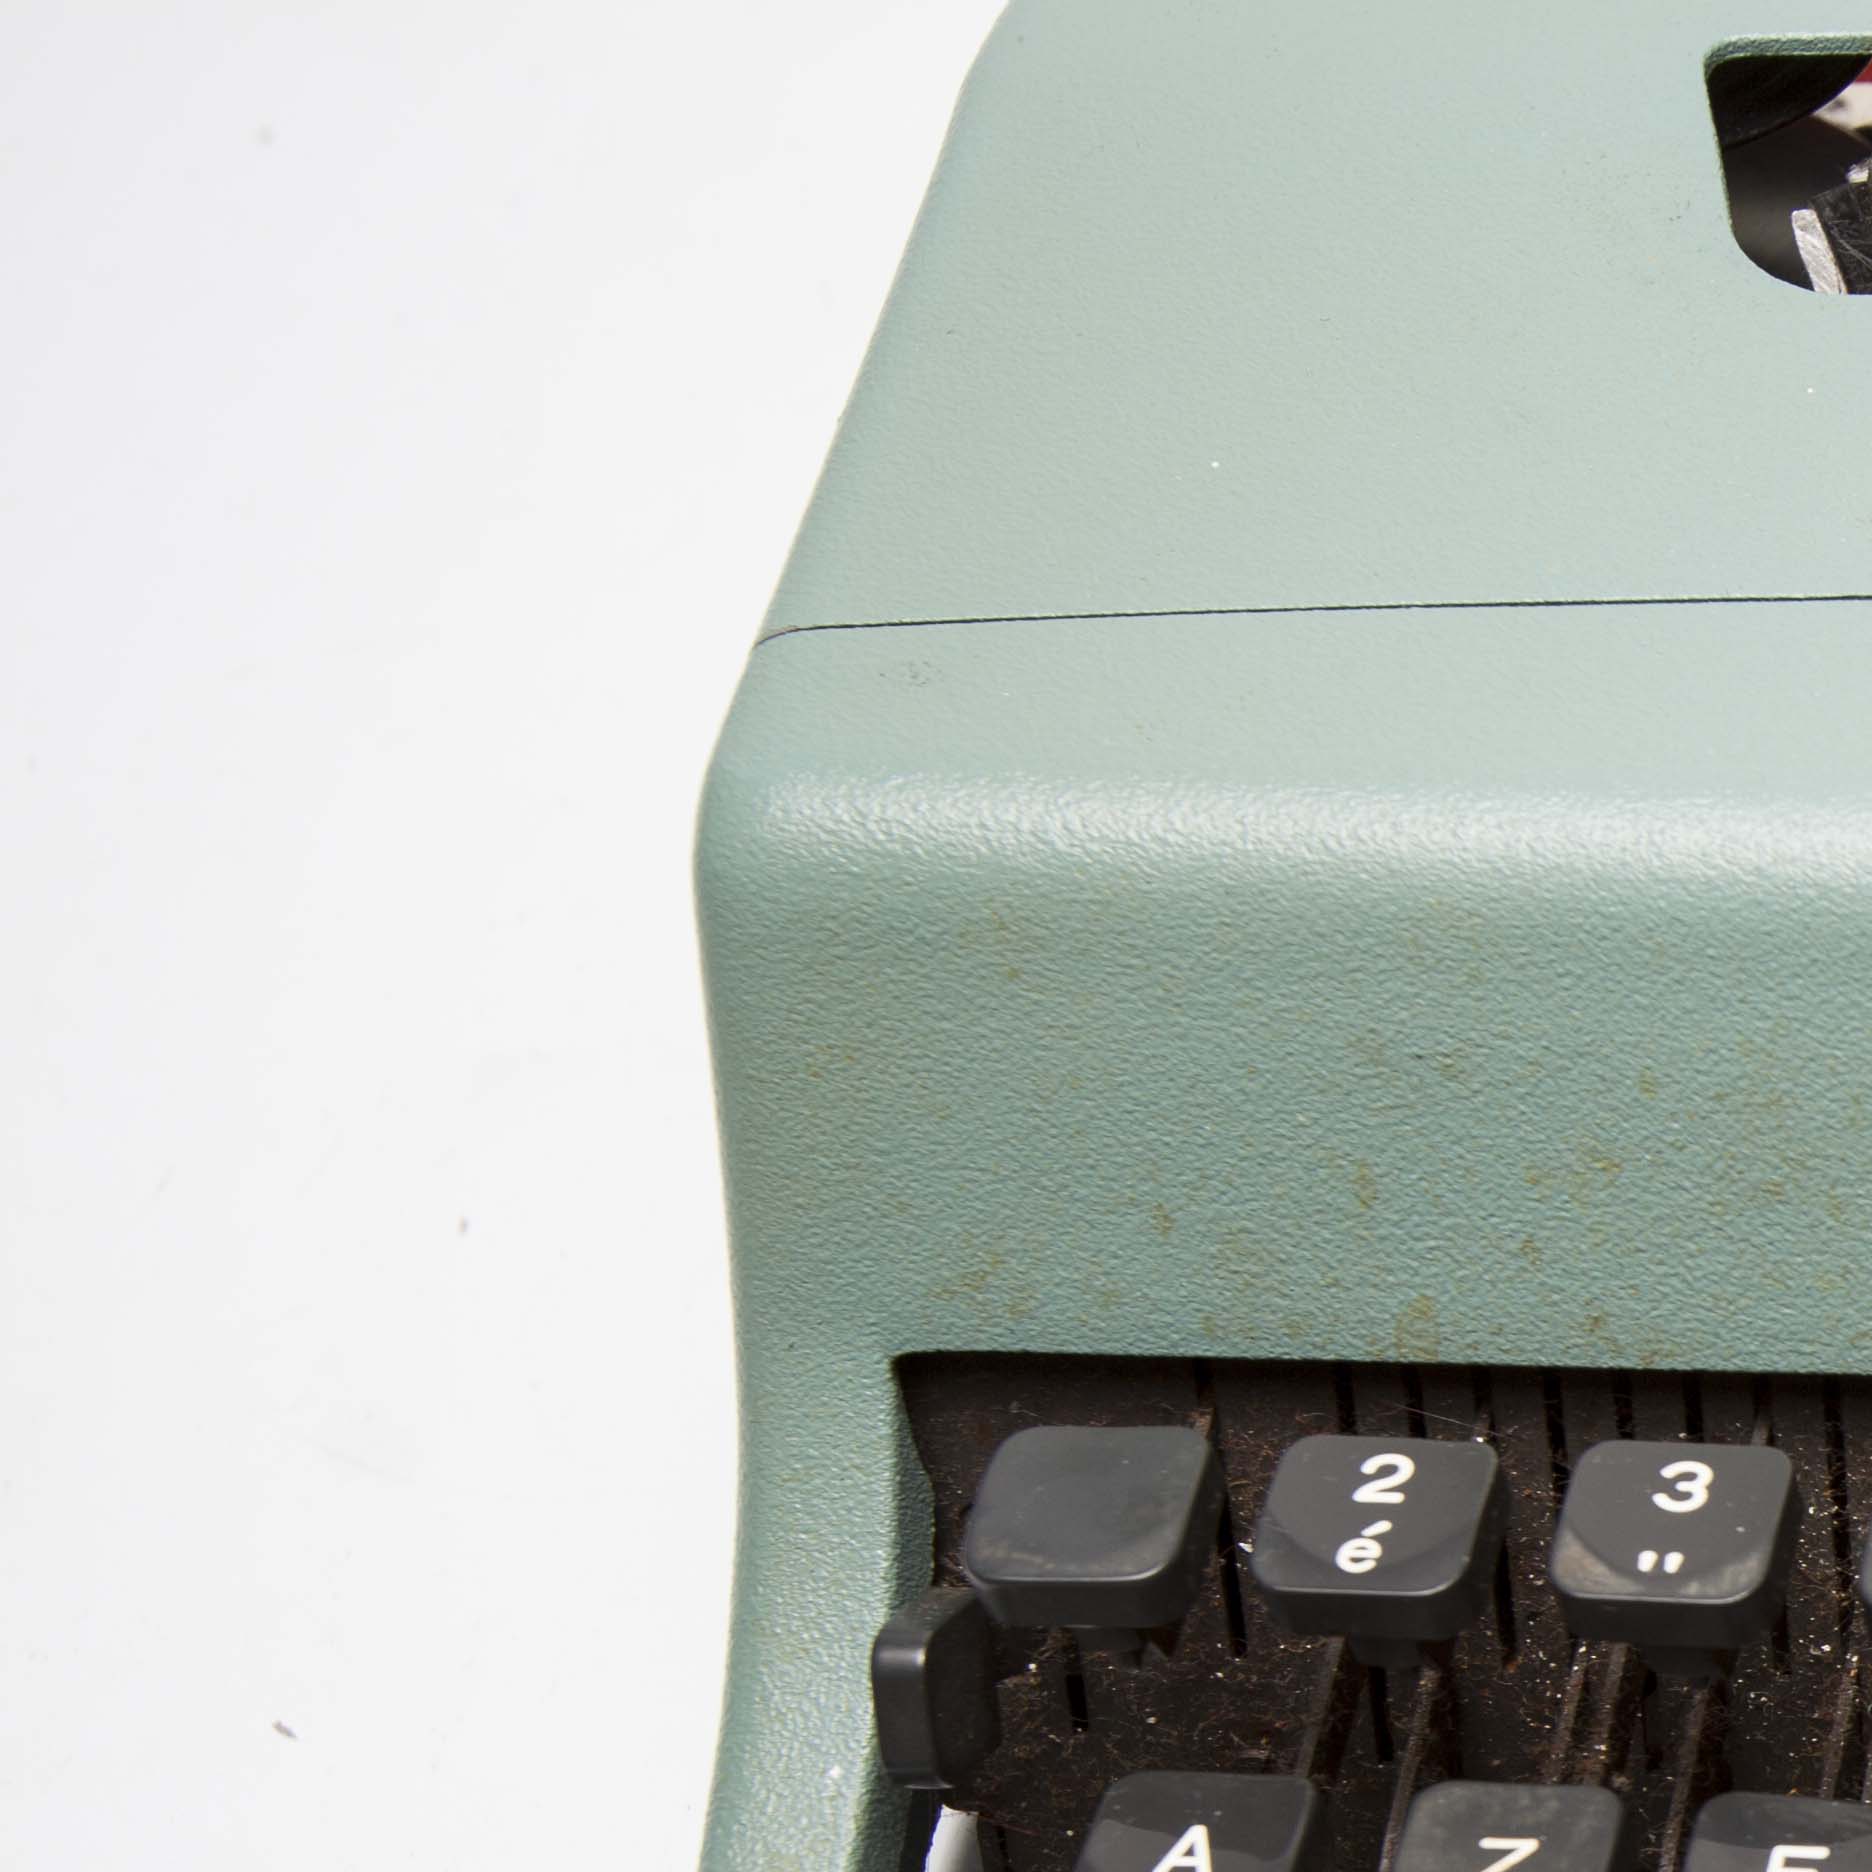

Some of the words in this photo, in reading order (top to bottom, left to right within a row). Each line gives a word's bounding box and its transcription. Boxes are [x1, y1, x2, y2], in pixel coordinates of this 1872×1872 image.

[1352, 1453, 1415, 1504] 2
[1652, 1460, 1714, 1513] 3
[1335, 1520, 1393, 1574] é
